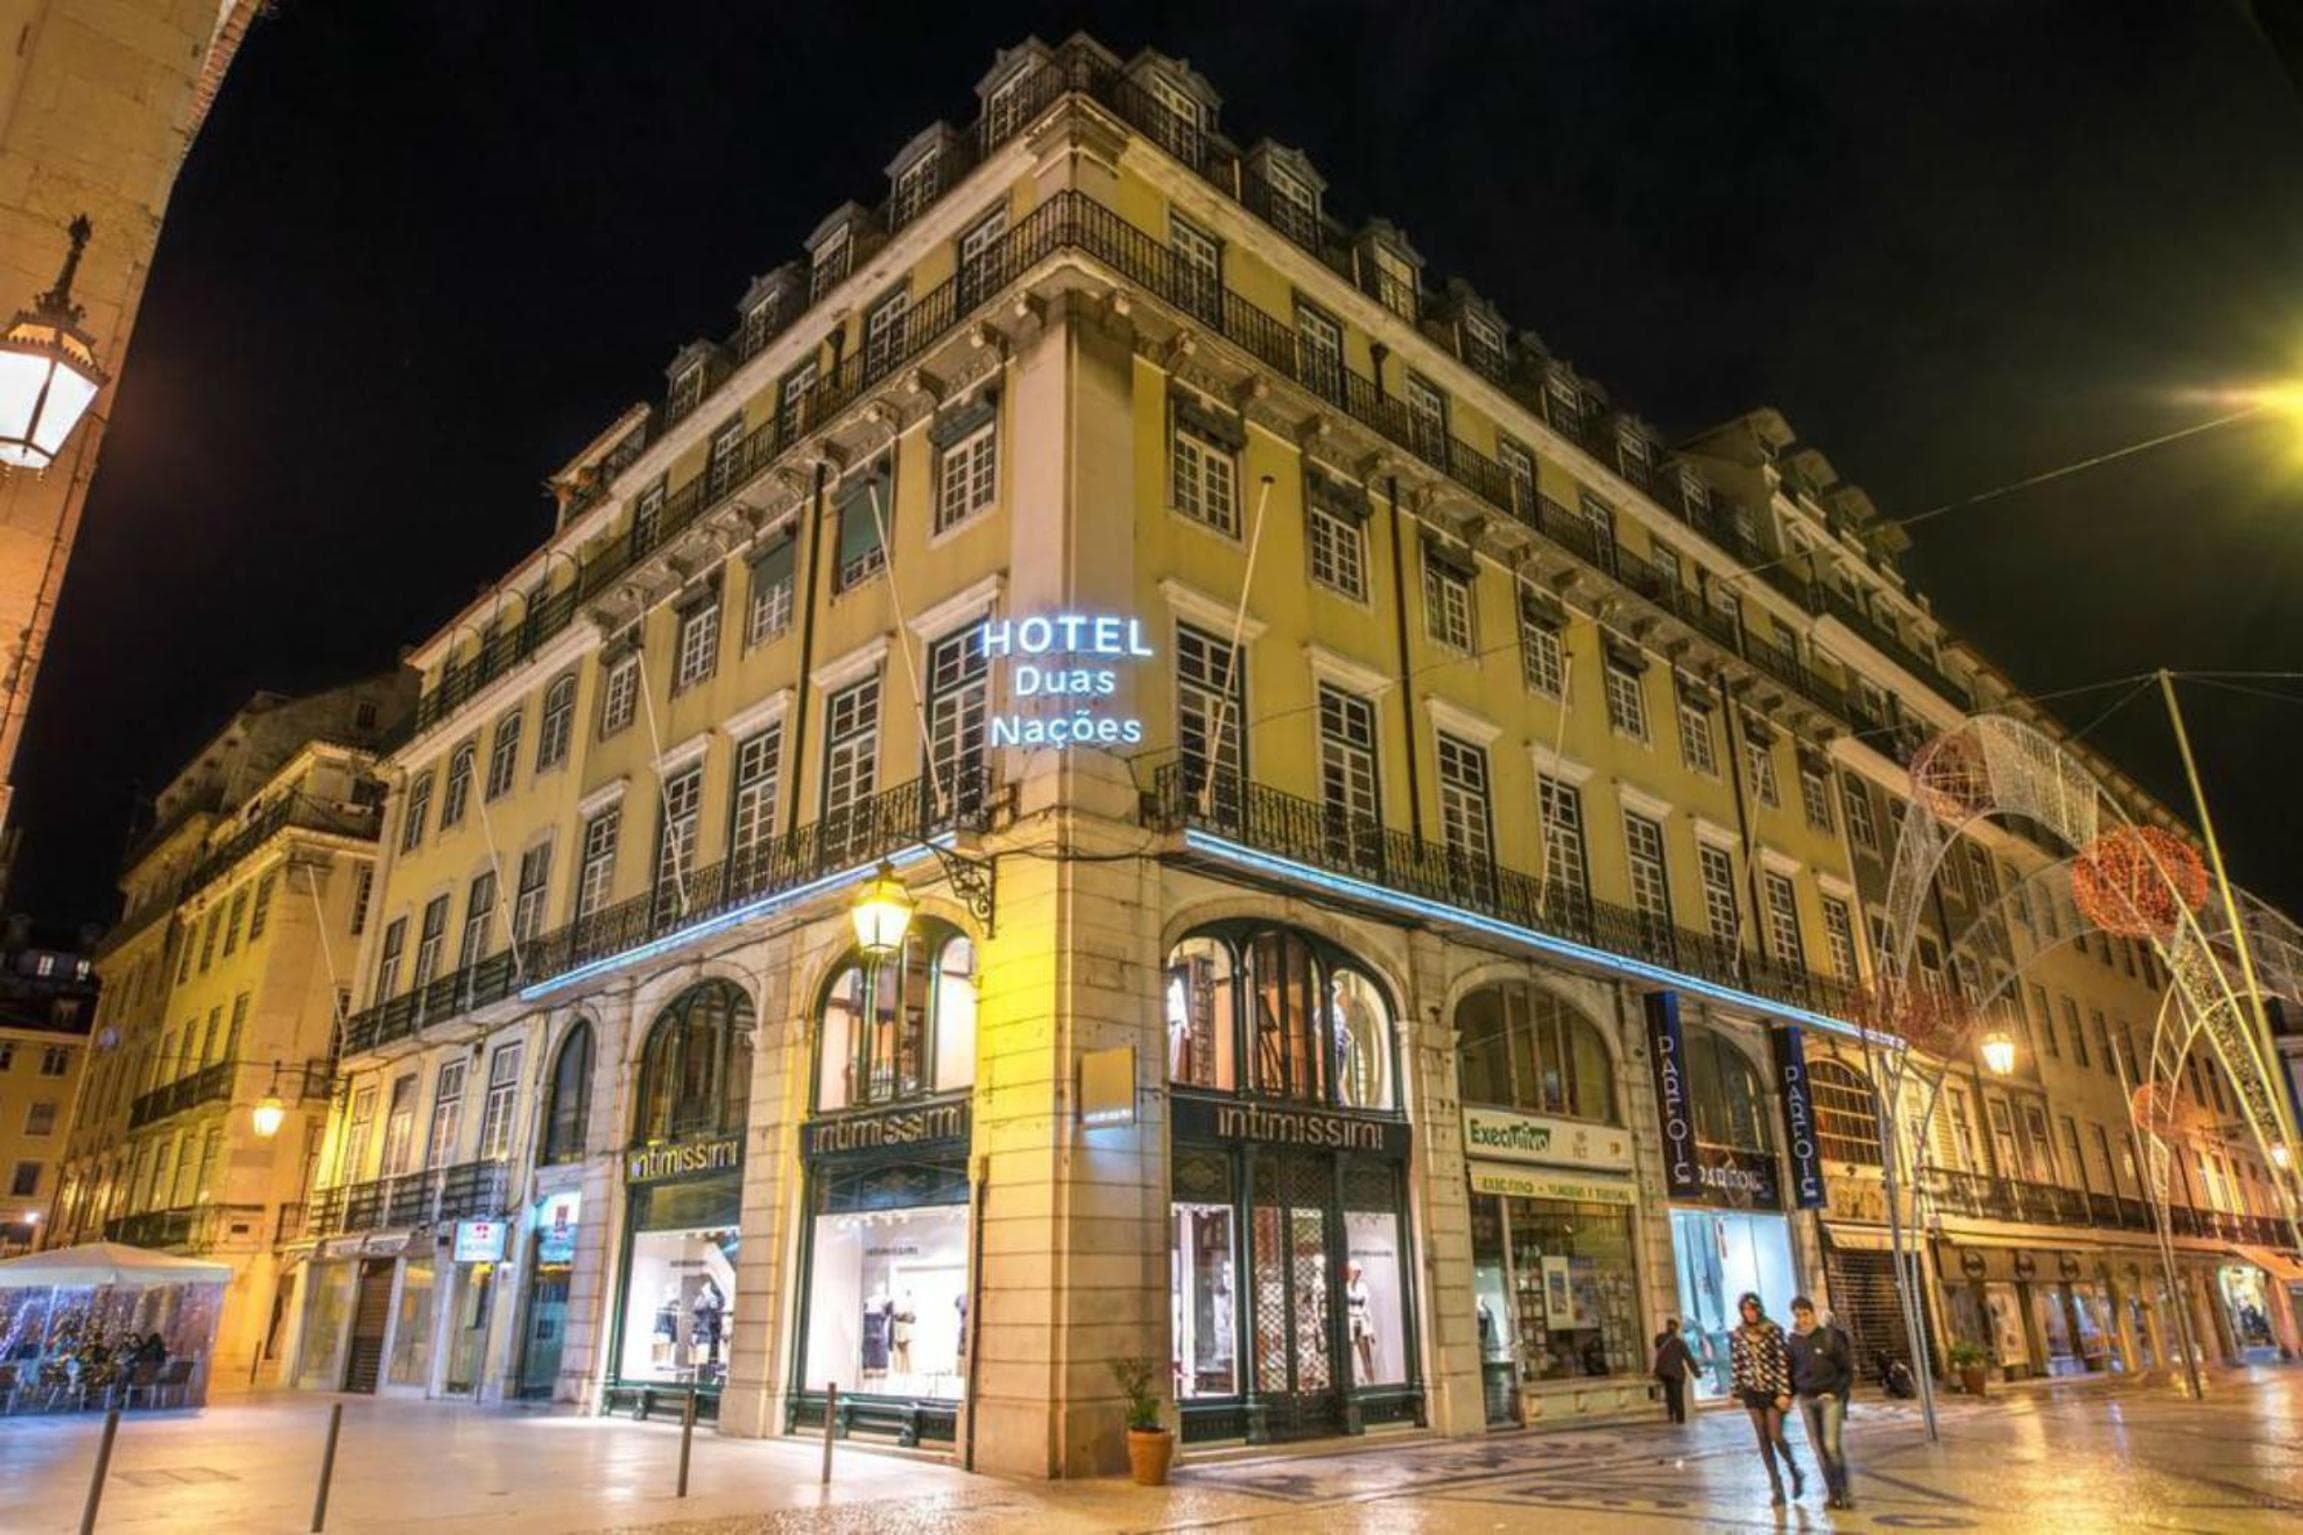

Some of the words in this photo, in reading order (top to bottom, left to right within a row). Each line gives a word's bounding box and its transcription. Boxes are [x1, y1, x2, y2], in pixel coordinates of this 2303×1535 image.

[982, 616, 1153, 657] HOTEL
[1016, 666, 1116, 696] Duas
[991, 710, 1142, 749] Nações
[812, 1106, 962, 1153] intimissimi
[1218, 1105, 1383, 1151] intimissimi
[1657, 1035, 1692, 1185] PARFOIS
[1784, 1065, 1818, 1198] PARFOIS
